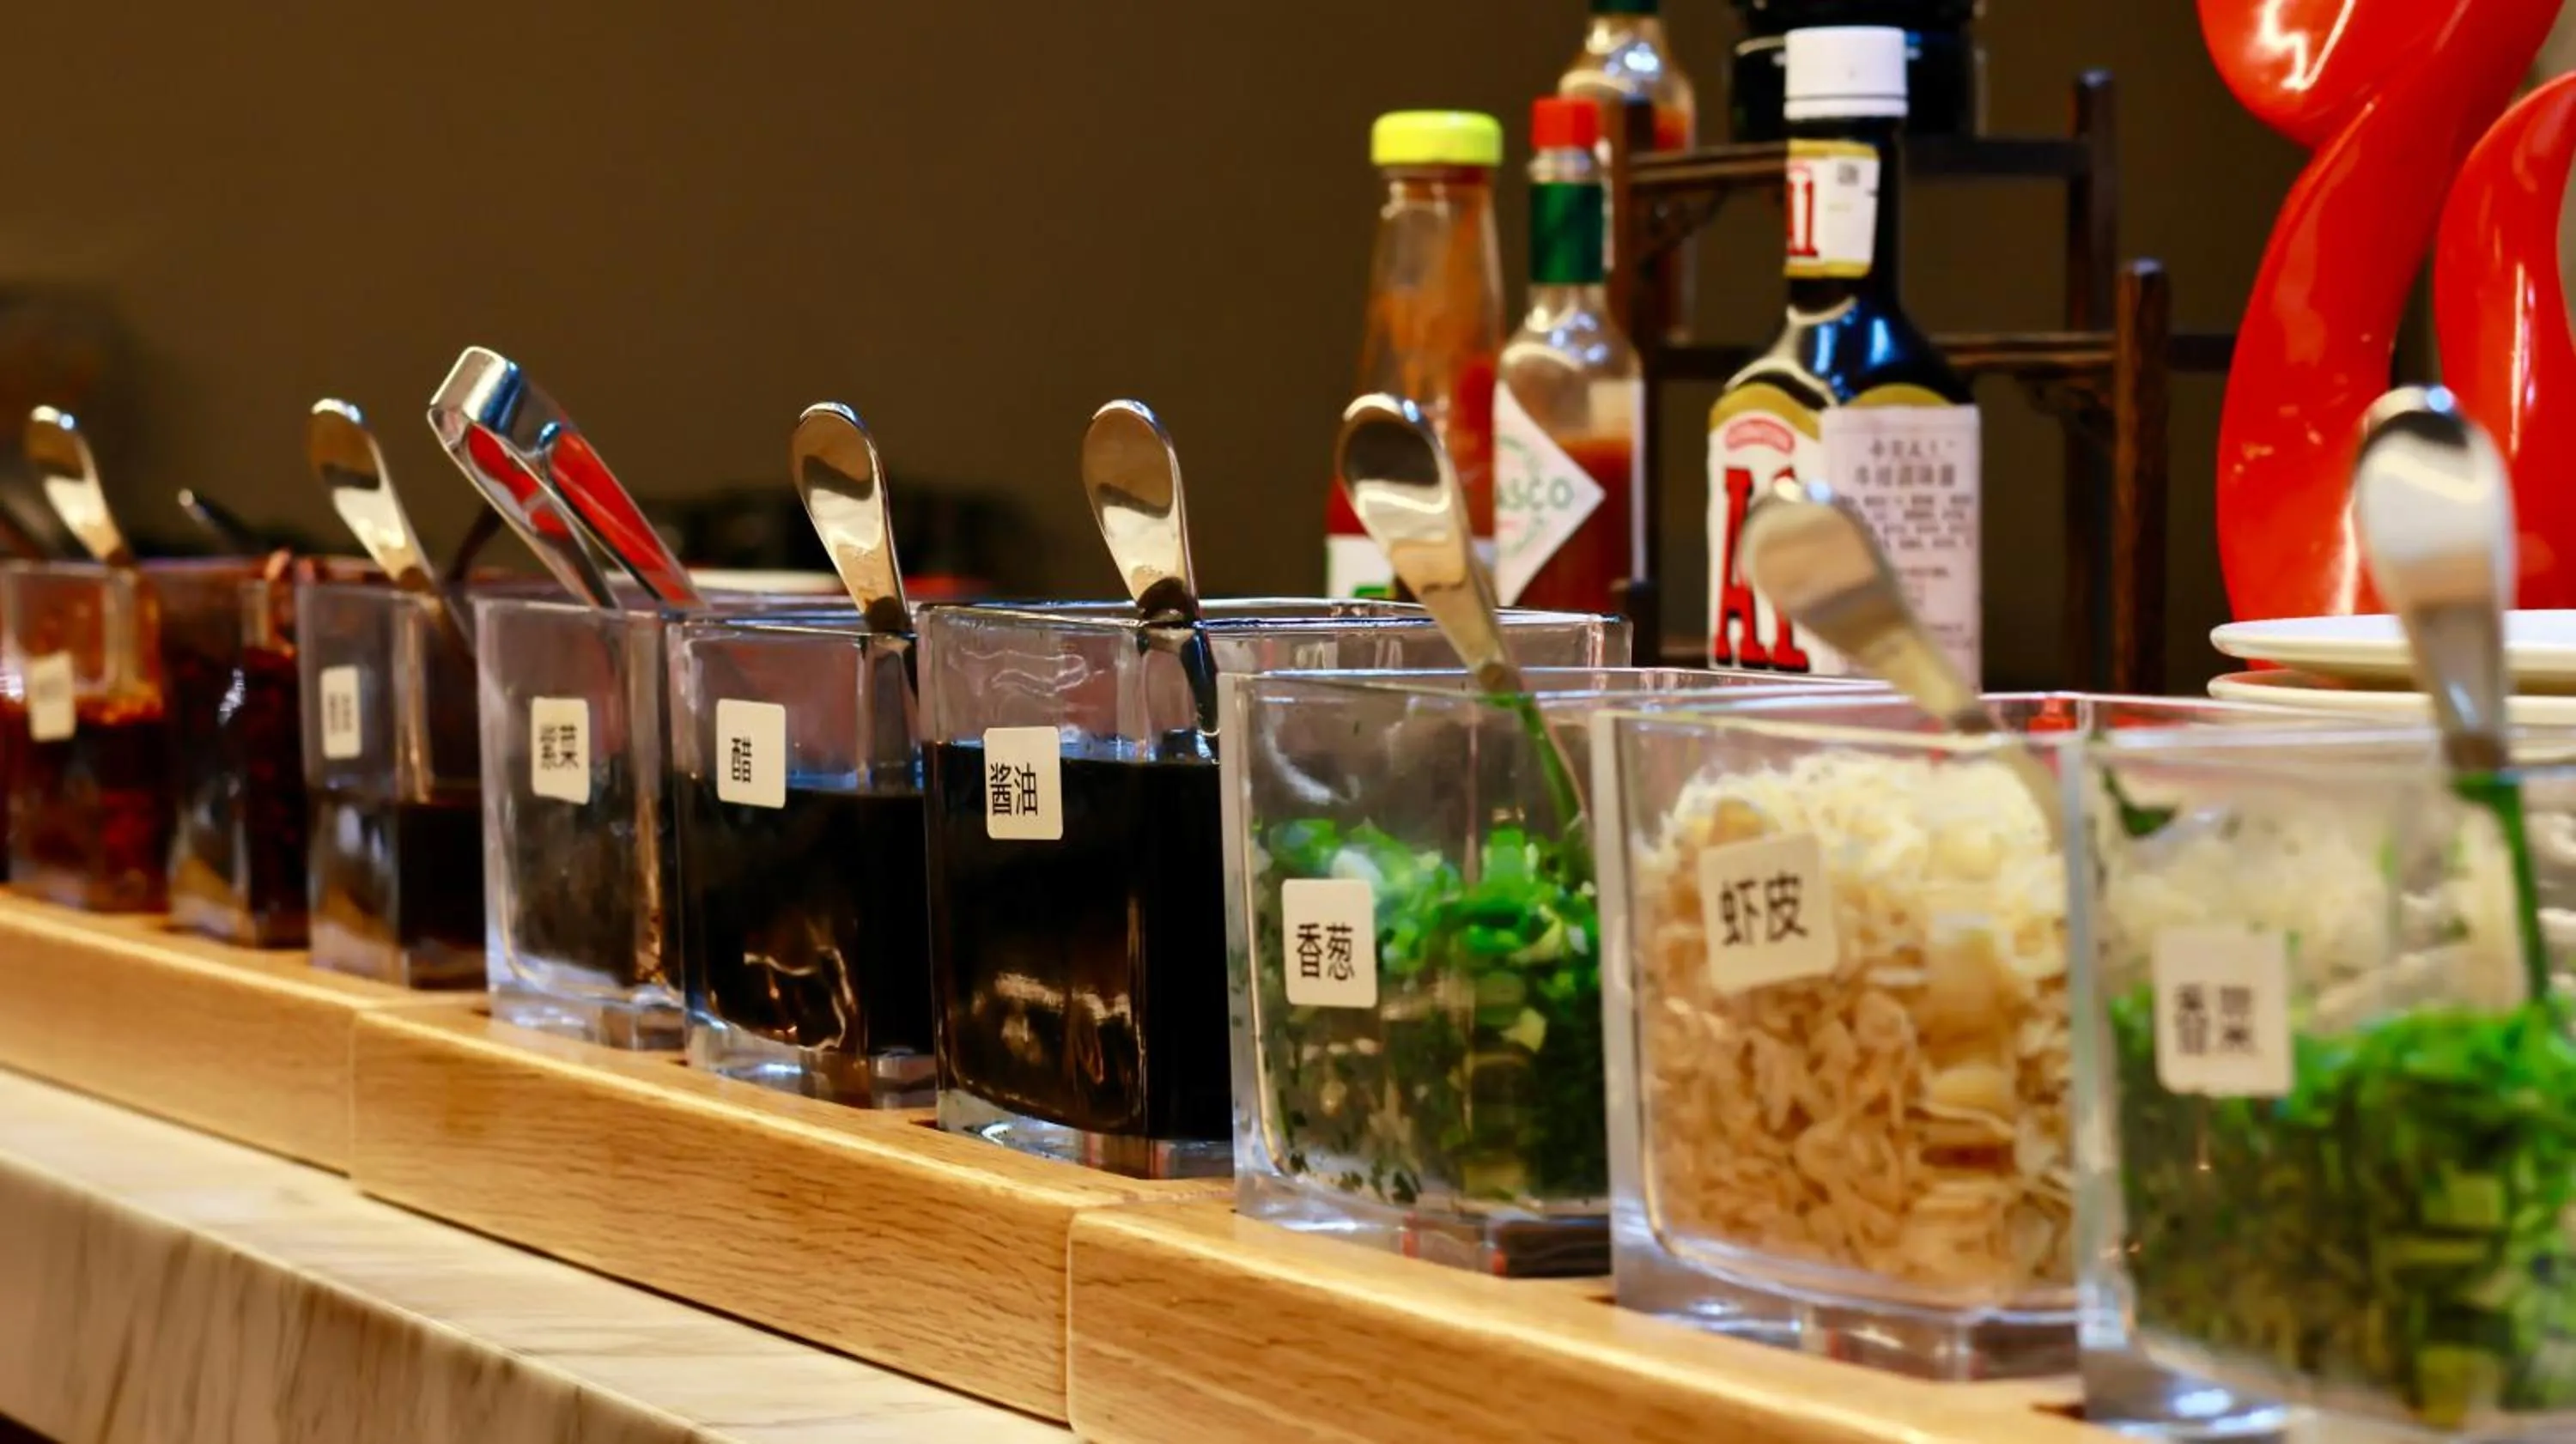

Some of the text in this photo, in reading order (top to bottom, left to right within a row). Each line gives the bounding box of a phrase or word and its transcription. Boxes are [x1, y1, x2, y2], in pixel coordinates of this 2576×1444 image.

[731, 736, 752, 783] 醋
[990, 762, 1038, 816] 酱油
[1719, 871, 1809, 947] 虾皮
[1297, 922, 1356, 980] 香葱
